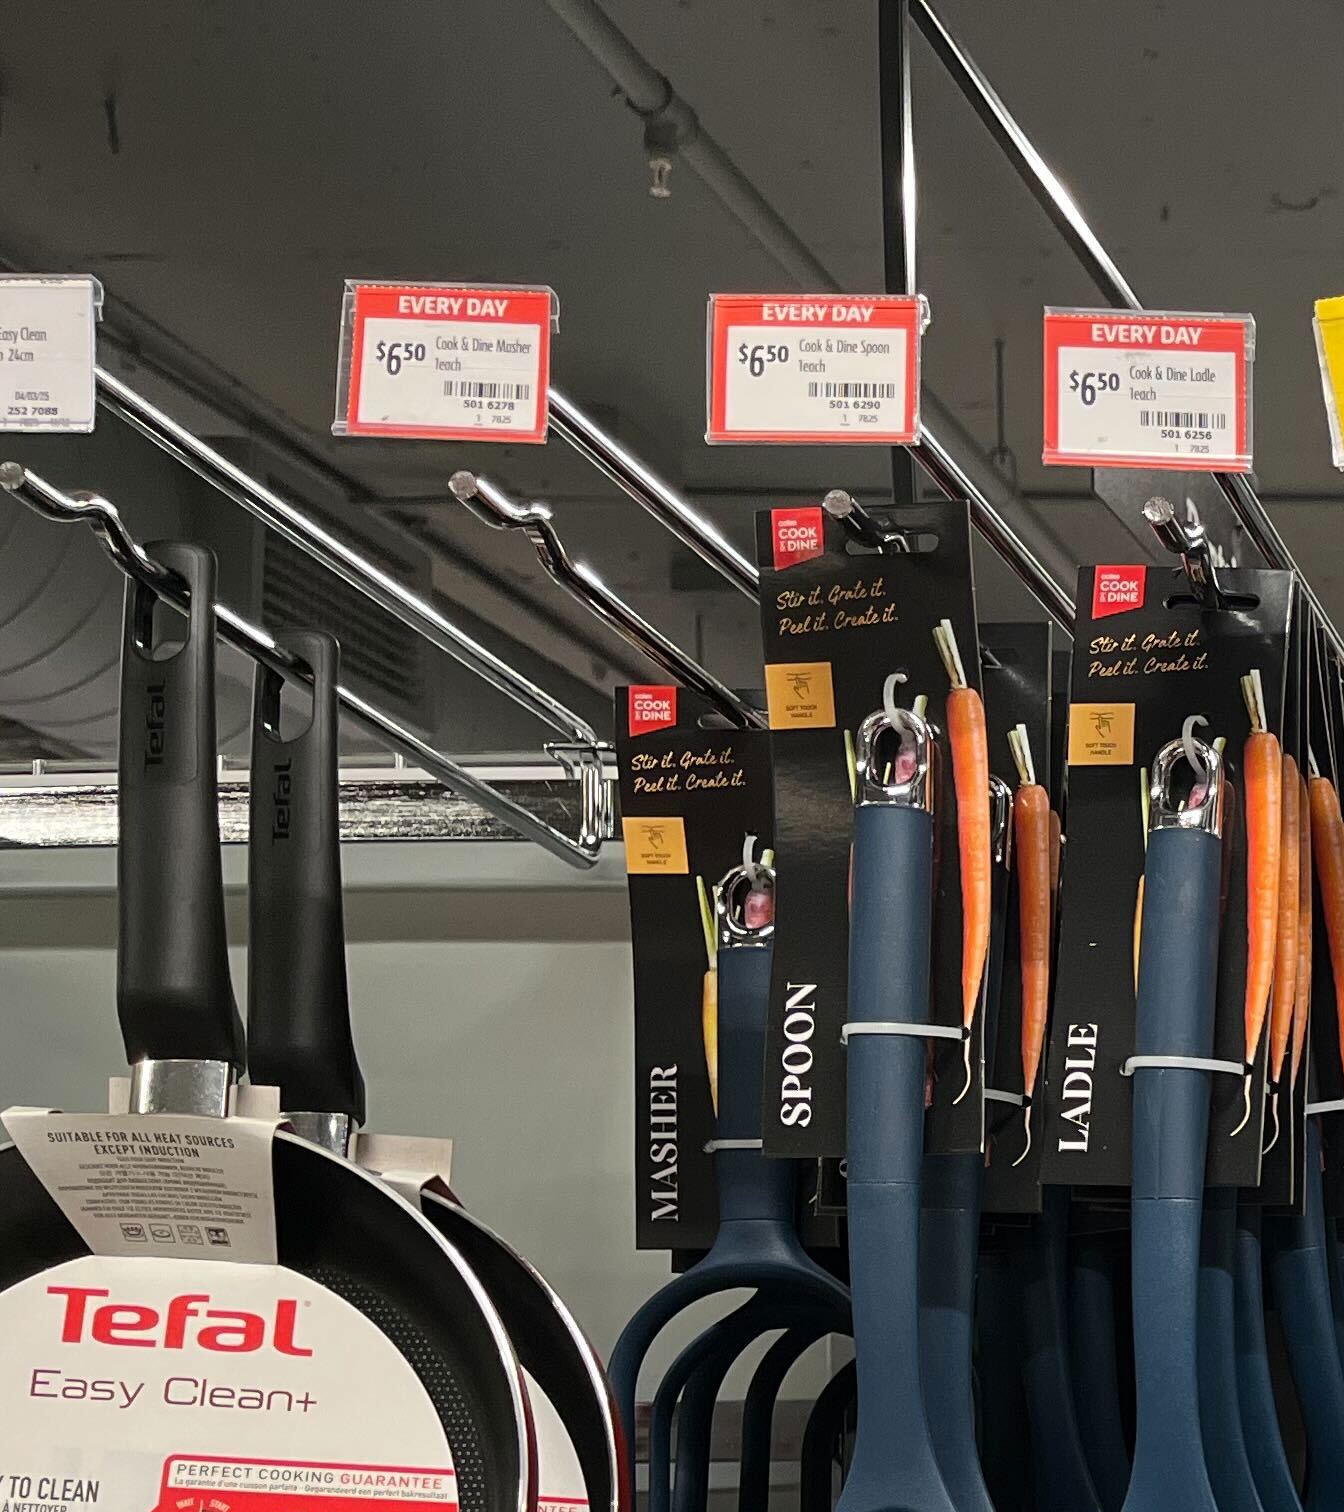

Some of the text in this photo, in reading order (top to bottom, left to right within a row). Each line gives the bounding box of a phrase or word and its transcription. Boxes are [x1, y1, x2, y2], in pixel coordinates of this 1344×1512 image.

[399, 296, 508, 317] EVERY DAY
[762, 303, 874, 322] EVERY DAY
[436, 336, 531, 354] Cook & Dine Masher
[1092, 324, 1202, 345] EVERY DAY
[799, 339, 889, 356] Cook & Dine Spoon
[778, 527, 817, 540] COOK
[1100, 581, 1138, 592] COOK
[780, 982, 818, 1129] SPOON
[1058, 1022, 1098, 1153] LADLE
[47, 1131, 235, 1149] SUITABLE FOR ALL HEAT SOURCES
[650, 1063, 679, 1223] MASHER
[94, 1144, 200, 1158] EXCEPT INDUCTION
[47, 1285, 313, 1358] Tefal
[30, 1368, 318, 1414] Easy Clean+
[176, 1463, 253, 1480] PERFECT
[258, 1468, 335, 1485] COOKING
[340, 1472, 442, 1491] GUARANTEE
